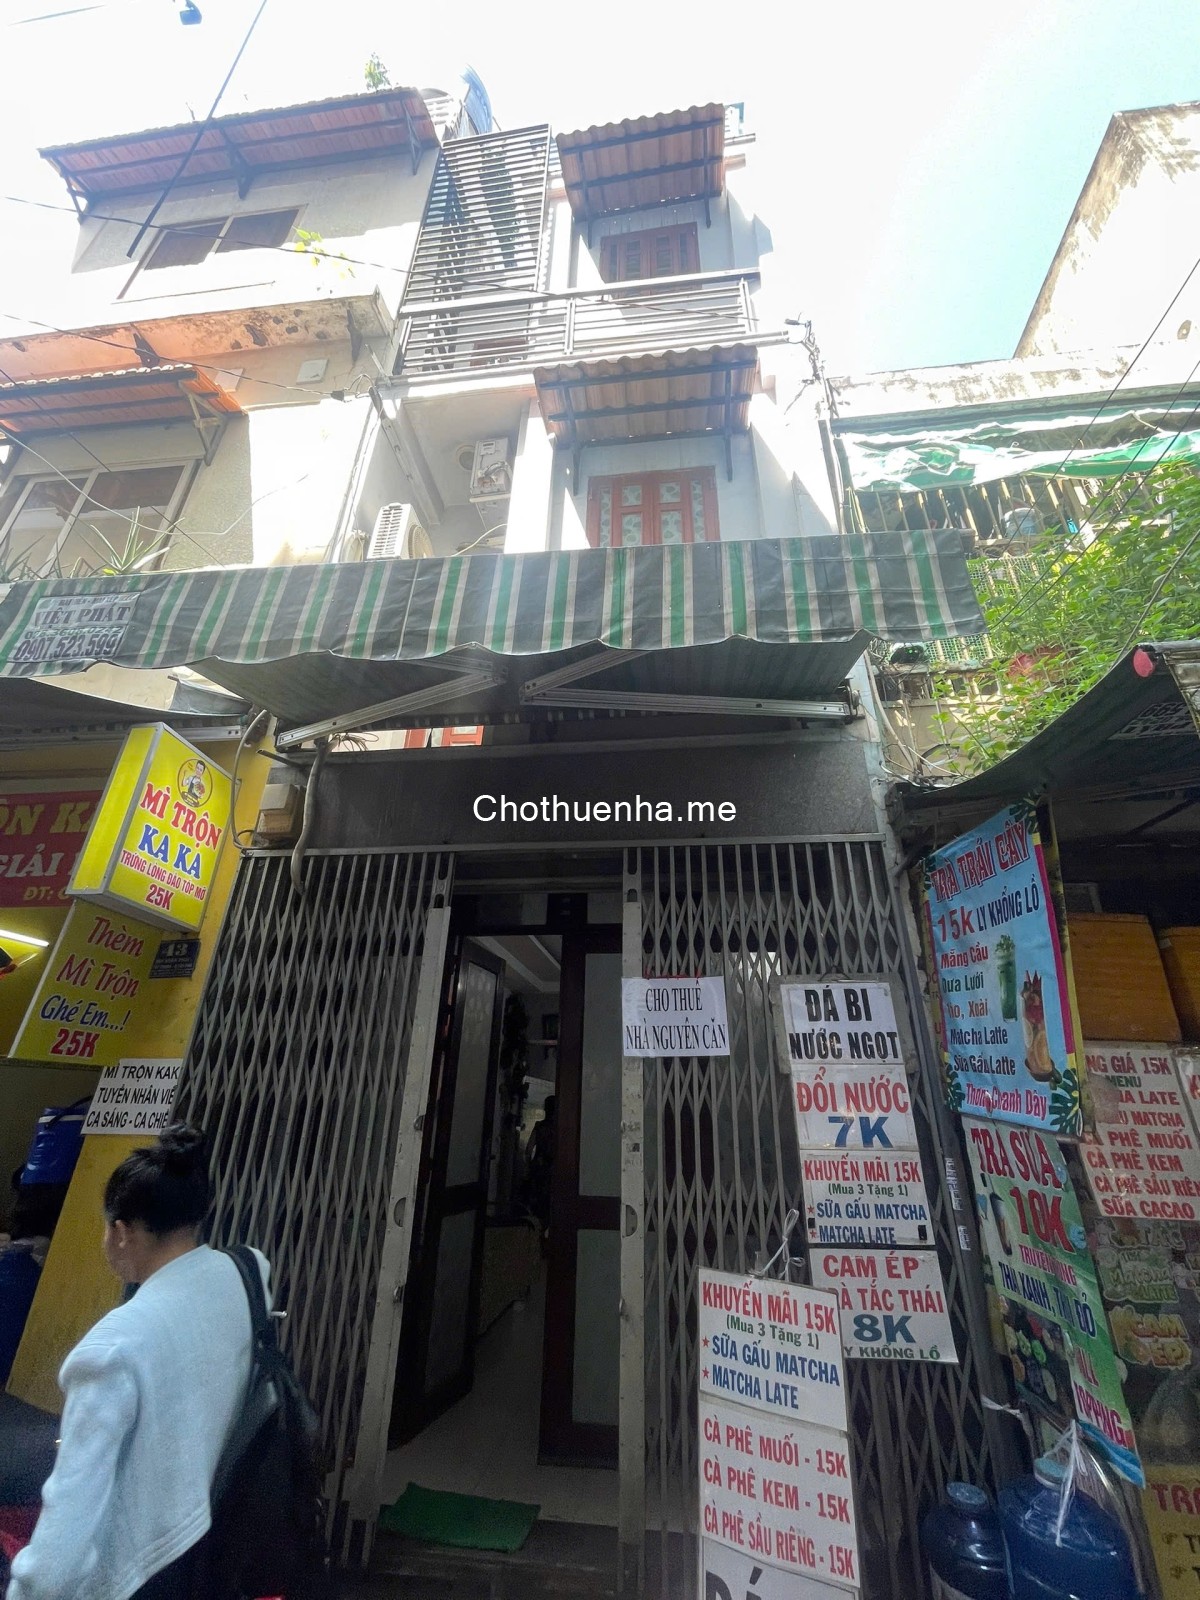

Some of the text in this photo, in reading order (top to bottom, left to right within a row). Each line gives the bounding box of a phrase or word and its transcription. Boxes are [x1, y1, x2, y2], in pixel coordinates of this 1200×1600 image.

[140, 783, 222, 850] MÌ TRỘN
[121, 849, 147, 872] TRỨNG
[138, 824, 201, 879] KA KA
[146, 884, 174, 910] 25K
[977, 906, 987, 932] LY
[1025, 873, 1040, 914] LỒ
[88, 916, 145, 957] Thèm
[969, 941, 989, 963] Cầu
[56, 953, 139, 1000] Mì Trộn
[965, 972, 984, 991] Lưới
[40, 994, 83, 1023] Ghé
[645, 980, 703, 1012] CHO THUÊ
[804, 985, 872, 1021] ĐÁ BI
[968, 998, 988, 1018] Xoài
[51, 1028, 100, 1057] 25K
[626, 1017, 727, 1049] NHÀ NGUYÊN CĂN
[789, 1028, 899, 1062] NƯỚC NGỌT
[984, 1026, 1008, 1045] Latte
[121, 1065, 154, 1082] TRỘN
[990, 1056, 1015, 1075] Latte
[1111, 1052, 1137, 1073] GIÁ
[1141, 1057, 1172, 1075] 15K
[131, 1085, 160, 1104] NHÂN
[796, 1066, 909, 1113] ĐỔI NƯỚC
[1139, 1091, 1180, 1106] LATE
[87, 1111, 101, 1127] CA
[101, 1107, 128, 1128] SÁNG
[134, 1112, 148, 1128] CA
[1131, 1111, 1185, 1128] MATCHA
[828, 1117, 893, 1148] 7K
[1107, 1128, 1143, 1148] PHÊ
[1146, 1128, 1193, 1150] MUỐI
[804, 1153, 921, 1182] KHUYẾN MÃI 15K
[1087, 1149, 1184, 1172] CÀ PHÊ KEM
[828, 1183, 908, 1198] (Mua 3 Tặng 1)
[816, 1197, 927, 1221] SỮA GẤU MATCHA
[1010, 1186, 1076, 1254] 10K
[1139, 1200, 1195, 1220] CACAO
[819, 1225, 897, 1244] MATCHA LATE
[823, 1250, 919, 1279] CAM ÉP
[702, 1280, 762, 1319] KHUYẾN
[767, 1290, 799, 1326] MÃI
[804, 1301, 837, 1335] 15K
[857, 1279, 894, 1311] TẮC
[898, 1284, 944, 1313] THÁI
[726, 1314, 819, 1350] (Mua 3 Tặng 1)
[853, 1314, 916, 1343] 8K
[712, 1333, 840, 1387] SỮA GẤU MATCHA
[712, 1364, 799, 1410] MATCHA LATE
[704, 1414, 721, 1444] CÀ
[726, 1425, 753, 1456] PHÊ
[759, 1433, 799, 1467] MUỐI
[816, 1448, 847, 1478] 15K
[704, 1455, 722, 1487] CÀ
[727, 1467, 756, 1500] PHÊ
[763, 1478, 799, 1511] KEM
[817, 1492, 850, 1524] 15K
[704, 1499, 719, 1535] CÀ
[722, 1510, 744, 1546] PHÊ
[749, 1512, 772, 1556] SẦU
[776, 1525, 815, 1569] RIÊNG
[828, 1545, 855, 1580] 15K
